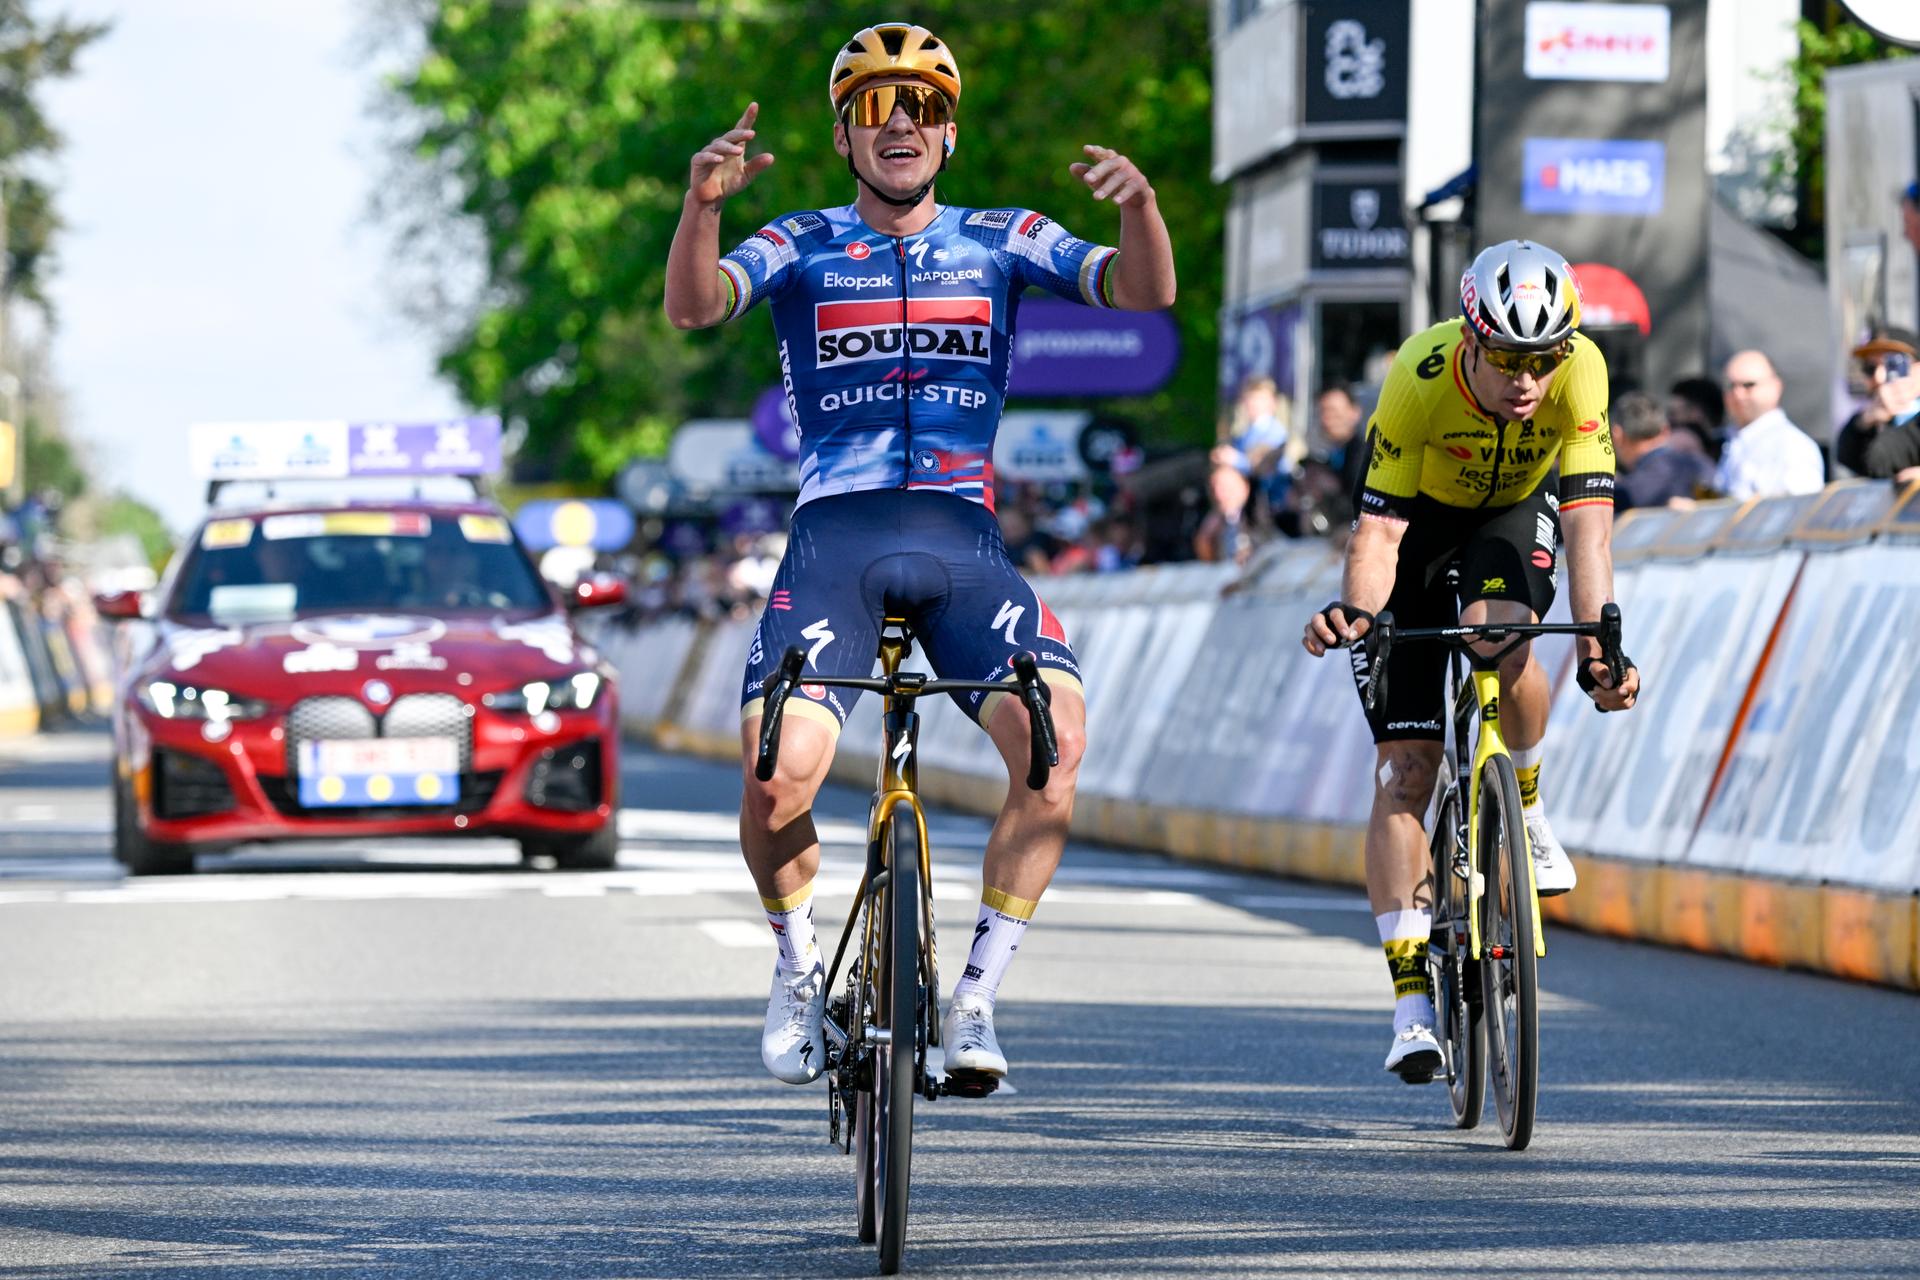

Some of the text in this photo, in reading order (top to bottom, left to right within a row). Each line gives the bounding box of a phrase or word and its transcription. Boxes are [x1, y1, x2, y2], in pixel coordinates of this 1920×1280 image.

[823, 272, 893, 290] Ekopak
[911, 268, 983, 283] NAPOLEON
[818, 328, 989, 364] SOUDAL
[1480, 447, 1548, 465] VISMA
[1386, 719, 1442, 731] cervélo
